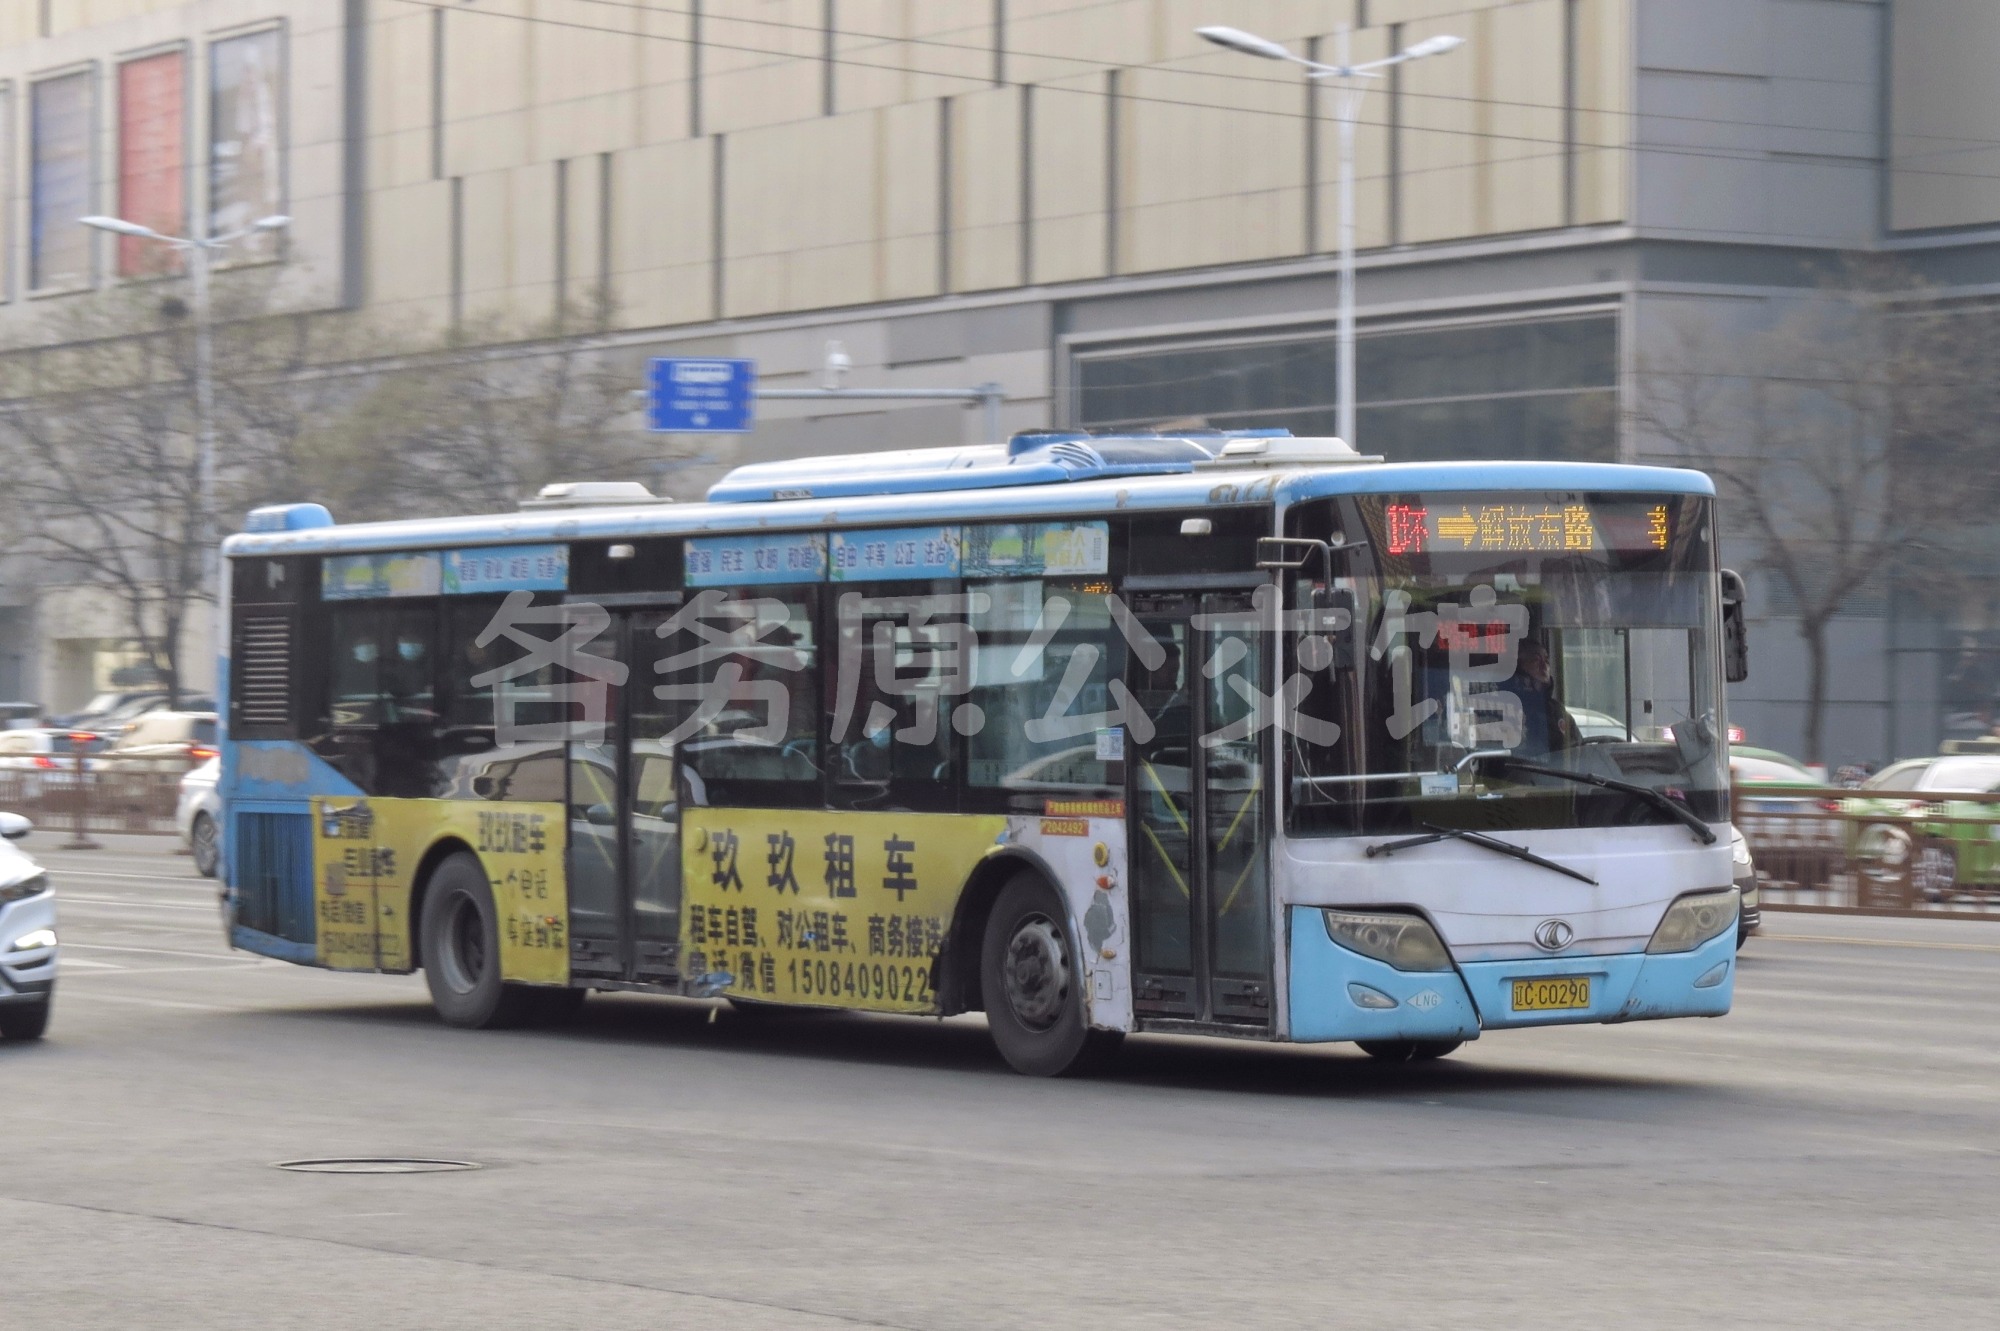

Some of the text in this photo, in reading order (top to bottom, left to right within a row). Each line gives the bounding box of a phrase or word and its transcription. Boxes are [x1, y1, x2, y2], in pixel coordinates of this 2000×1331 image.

[1478, 506, 1592, 549] 解放东路
[712, 828, 917, 902] 玖玖租车
[1415, 993, 1438, 1007] LNG
